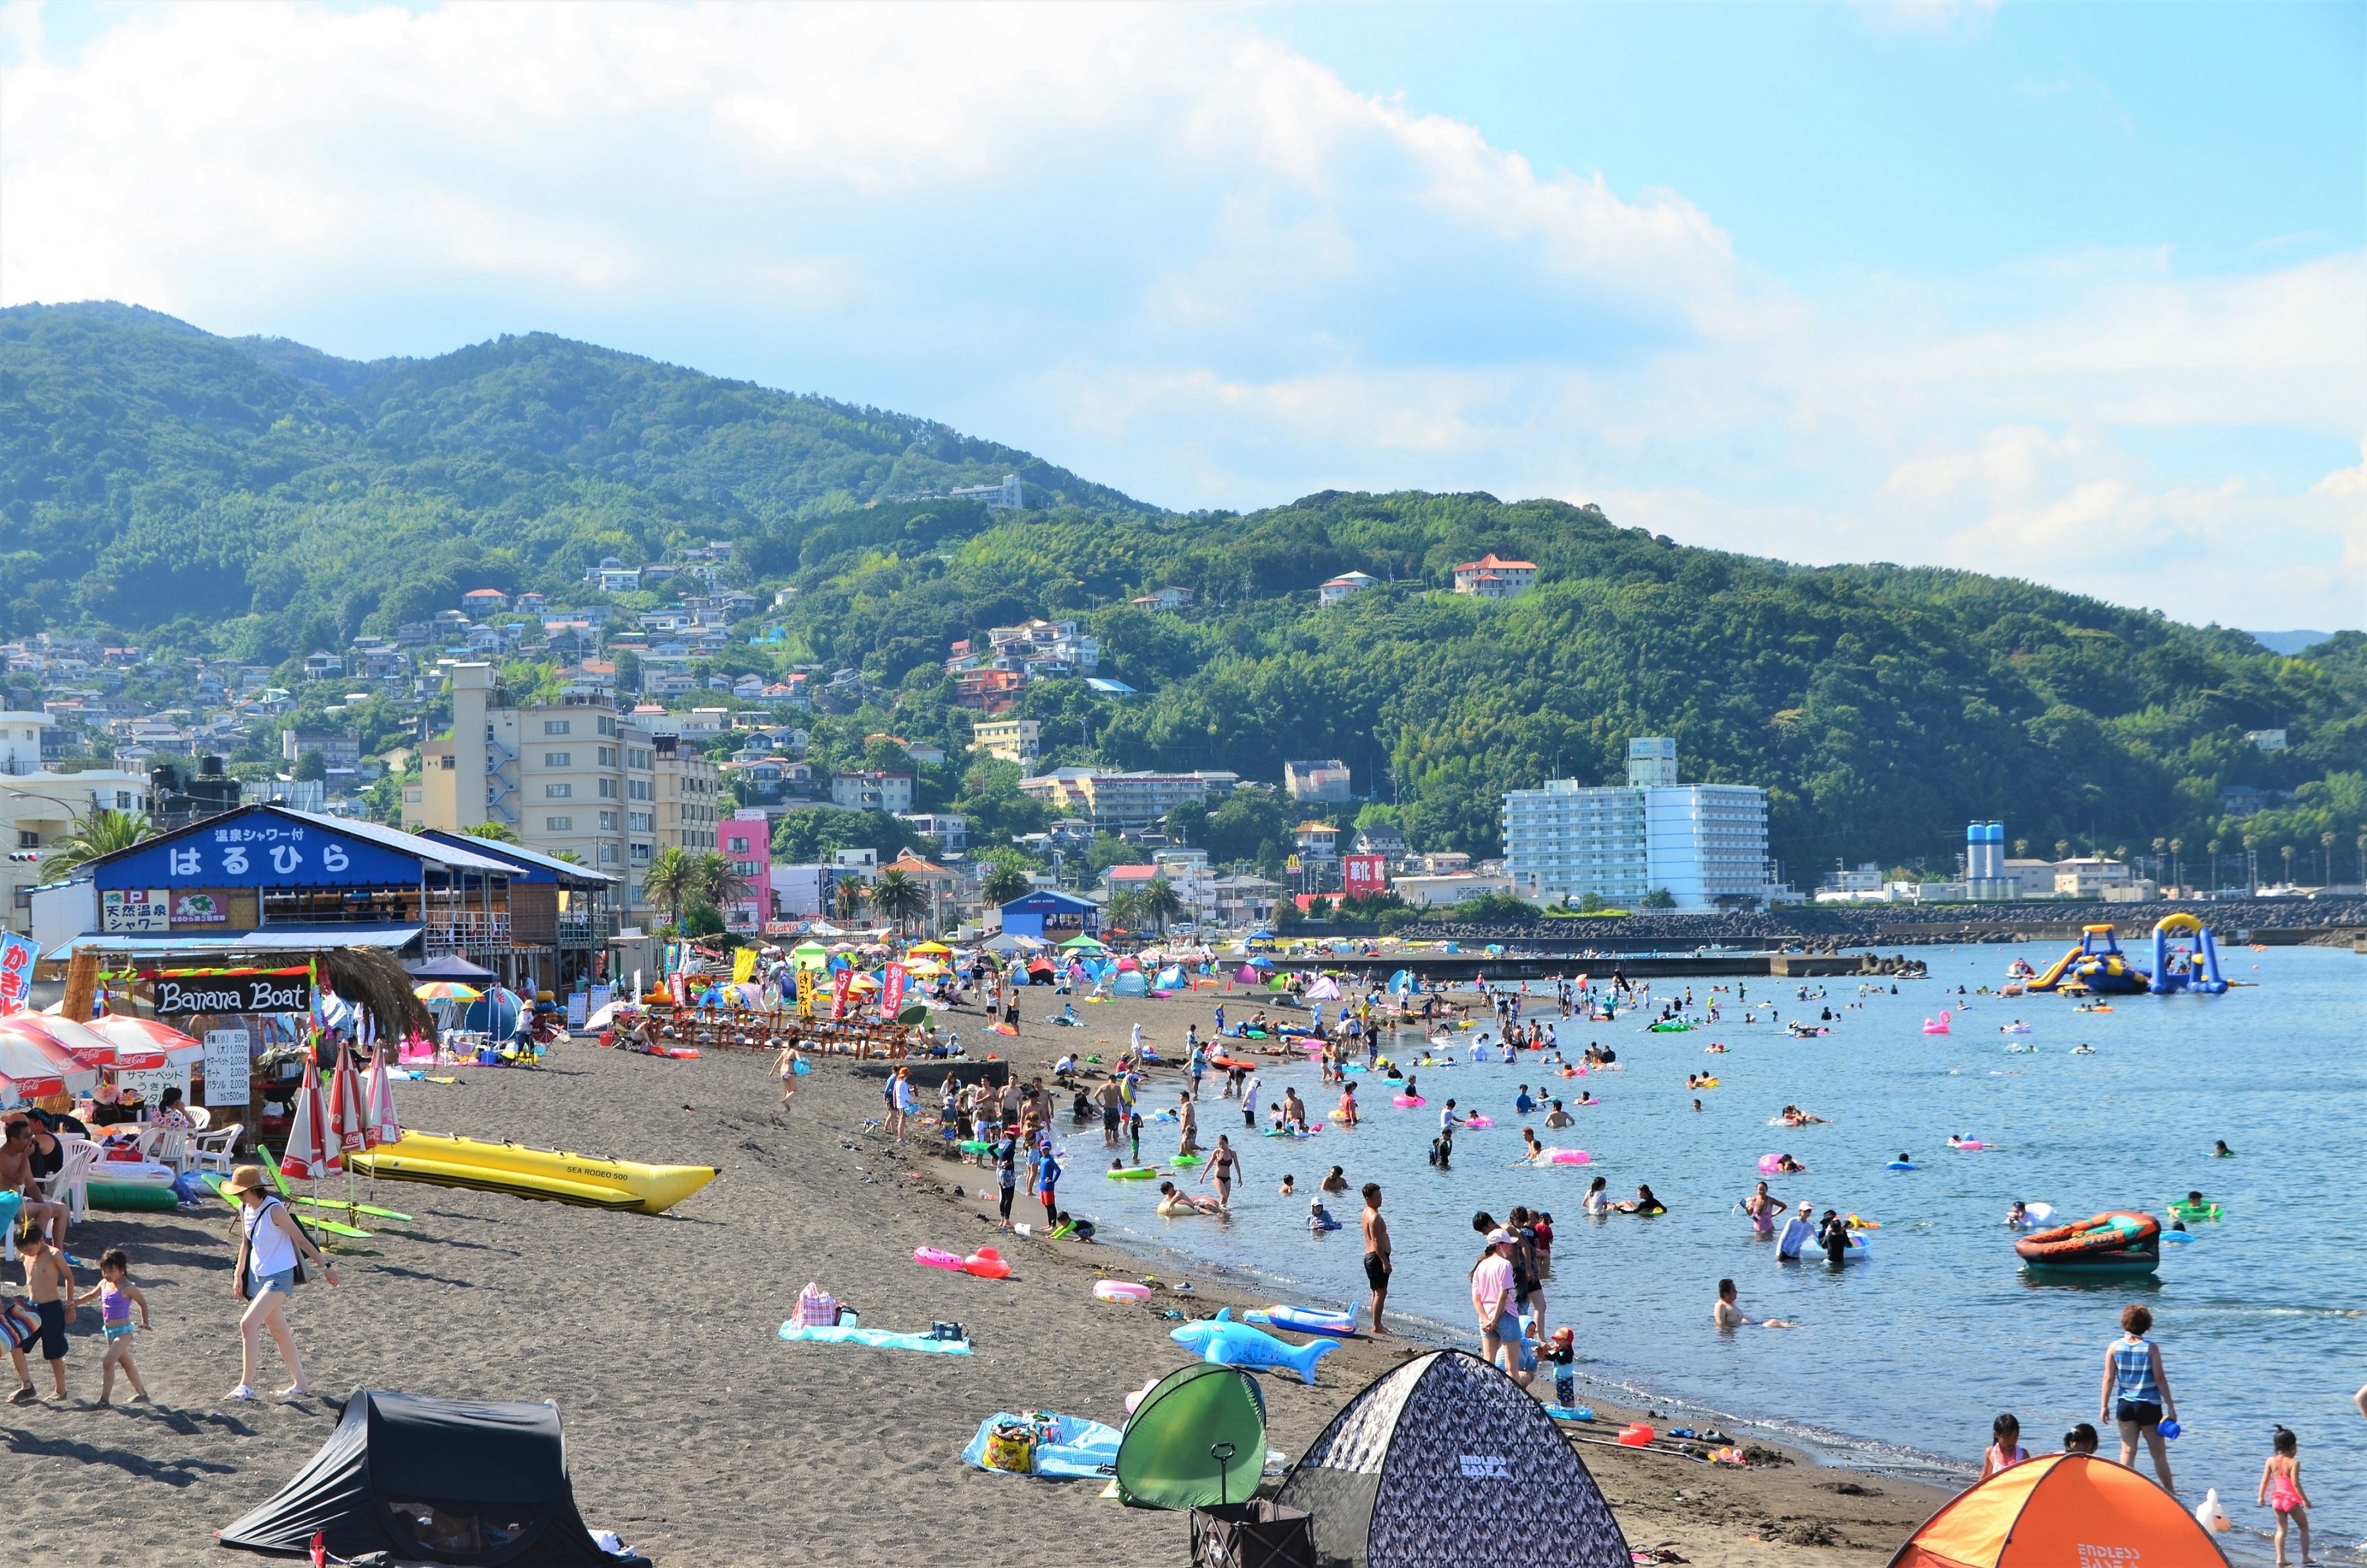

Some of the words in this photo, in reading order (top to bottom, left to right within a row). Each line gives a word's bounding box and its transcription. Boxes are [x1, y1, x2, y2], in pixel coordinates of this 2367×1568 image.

[215, 828, 304, 842] 温泉シャワー付
[170, 844, 349, 876] はるひら
[130, 891, 142, 904] P
[106, 904, 167, 917] 天然温泉
[110, 919, 163, 931] シャワー
[157, 983, 242, 1013] Banana
[248, 982, 305, 1010] Boat
[127, 1071, 183, 1080] サマーベッド
[584, 1168, 612, 1178] RODEO
[1459, 1455, 1507, 1465] ENDLESS
[1461, 1465, 1494, 1476] BASE
[2077, 1543, 2141, 1559] ENDLESS
